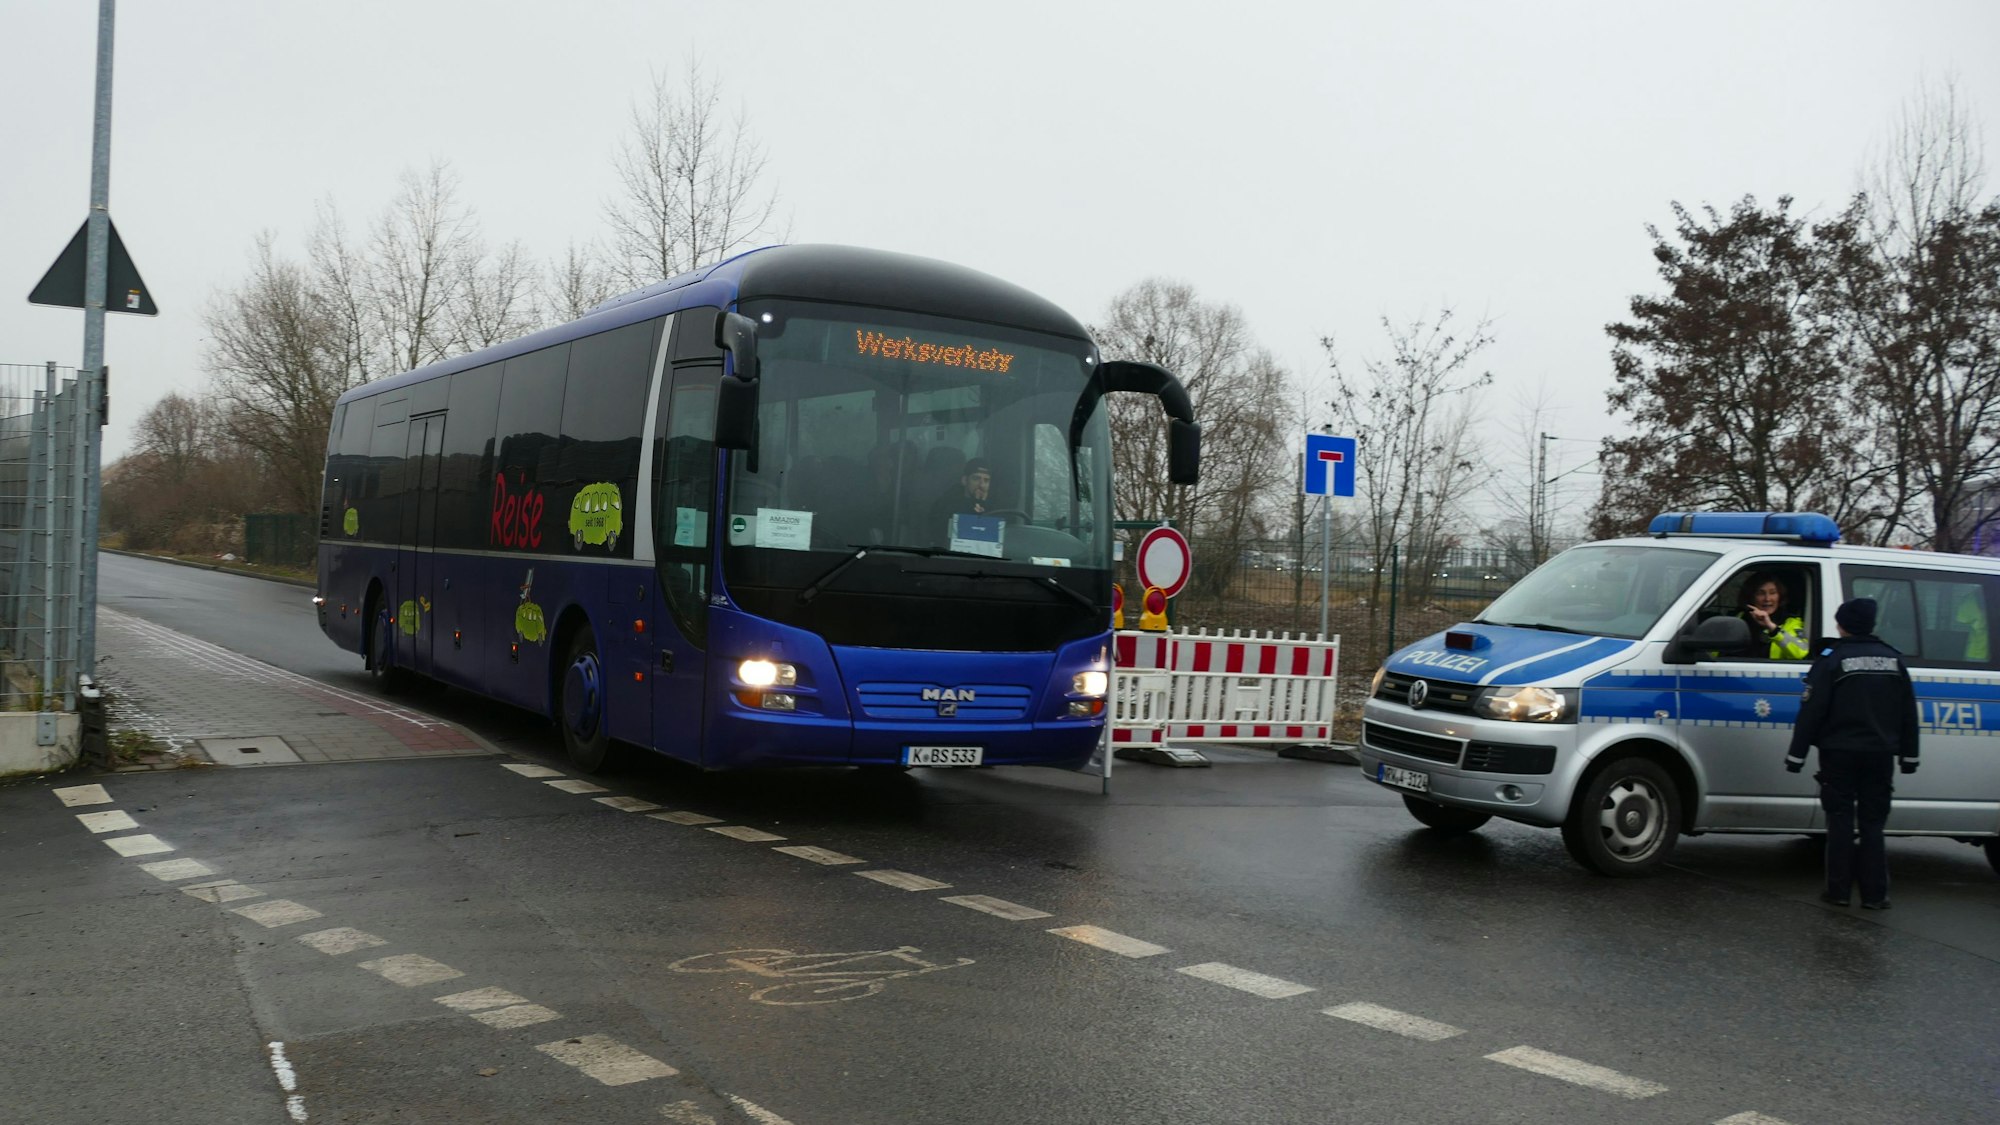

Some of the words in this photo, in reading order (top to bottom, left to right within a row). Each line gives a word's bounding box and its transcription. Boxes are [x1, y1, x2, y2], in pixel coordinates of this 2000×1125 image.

[856, 328, 1015, 373] Werksverkehr
[491, 472, 544, 549] Reise
[769, 515, 801, 525] AMAZON
[1399, 650, 1490, 674] POLIZEI
[922, 688, 975, 702] MAN
[1917, 702, 1982, 729] LIZEI
